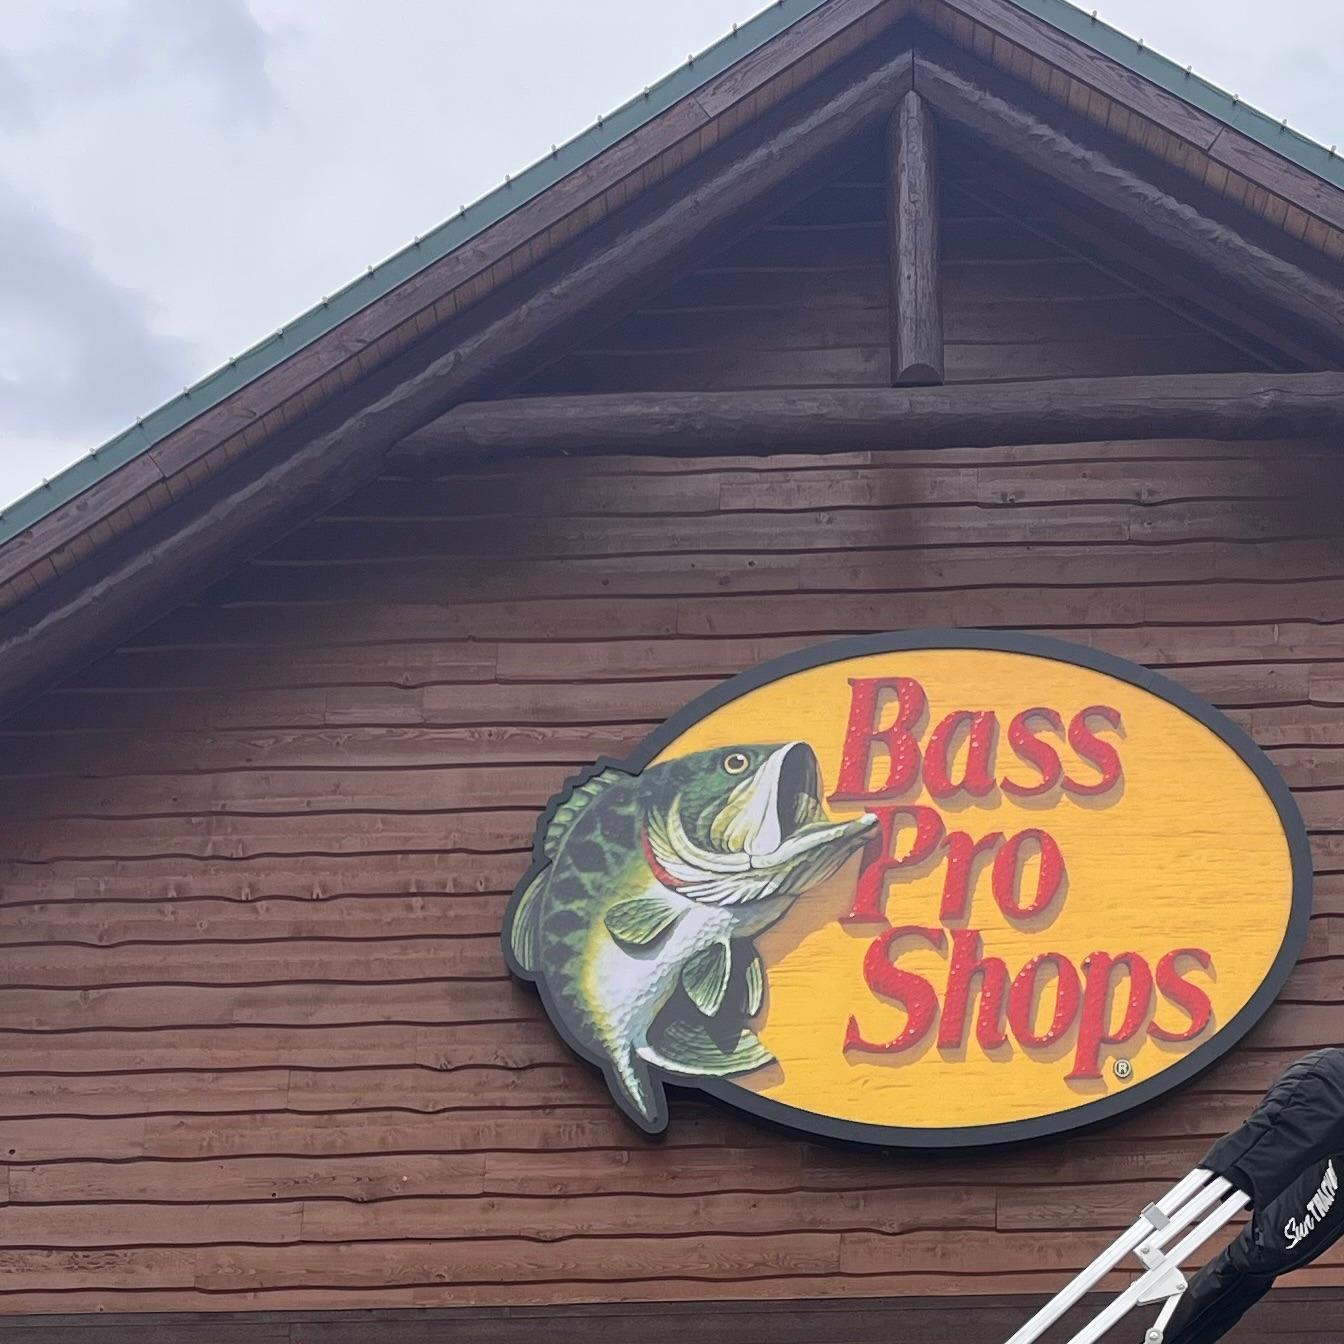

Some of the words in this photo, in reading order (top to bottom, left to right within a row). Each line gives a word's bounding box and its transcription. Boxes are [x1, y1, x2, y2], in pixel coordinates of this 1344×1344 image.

[826, 676, 1122, 801] Bass
[838, 805, 1066, 923] Pro
[843, 926, 1212, 1080] Shops
[1284, 1217, 1315, 1249] Sun
